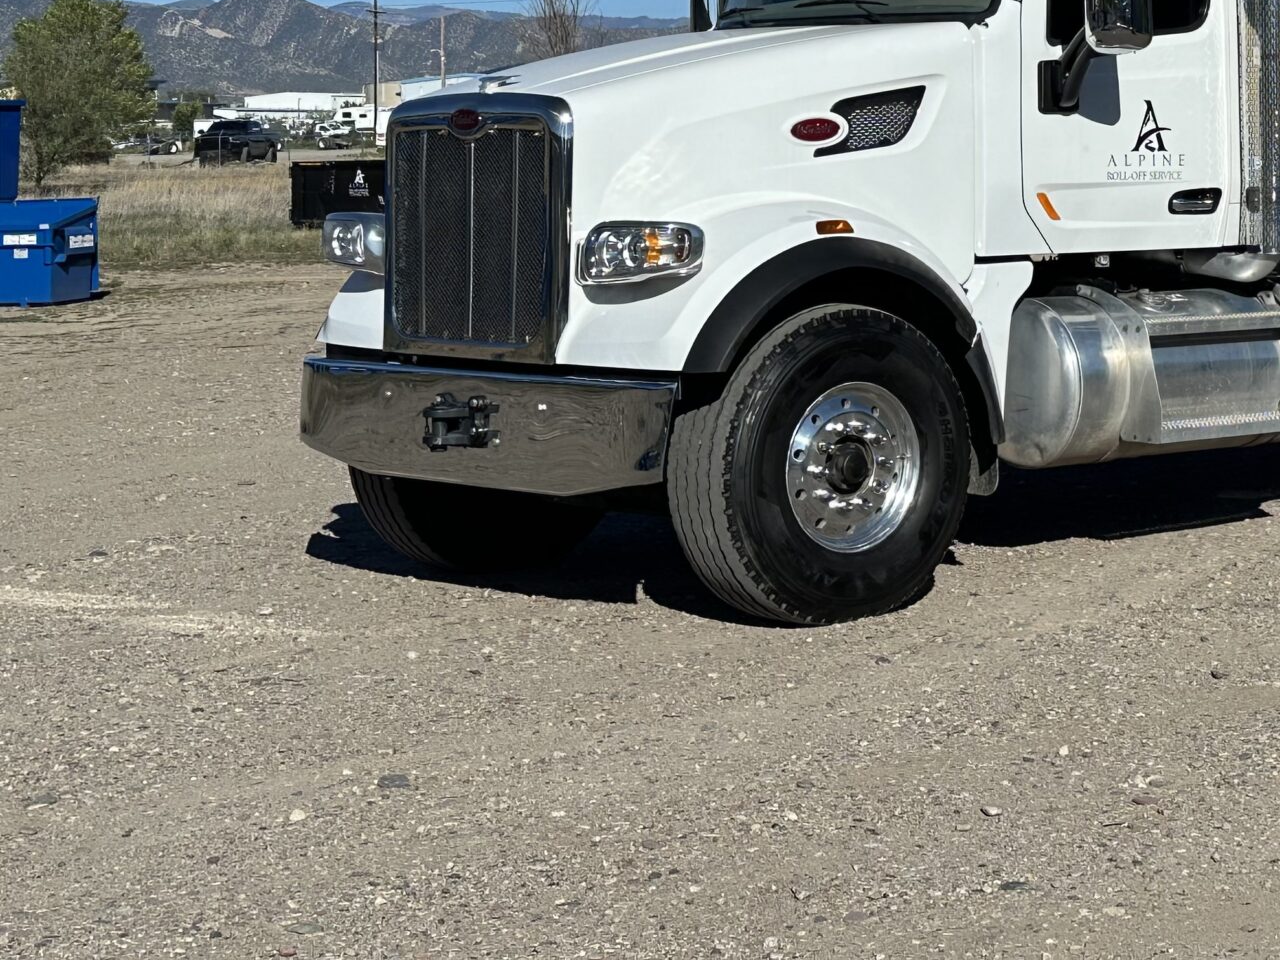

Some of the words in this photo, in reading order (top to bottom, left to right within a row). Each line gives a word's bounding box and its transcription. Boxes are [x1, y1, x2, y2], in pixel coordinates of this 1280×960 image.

[1107, 153, 1186, 167] ALPINE
[1106, 170, 1147, 181] ROLL-OFF
[1149, 170, 1182, 181] SERVICE
